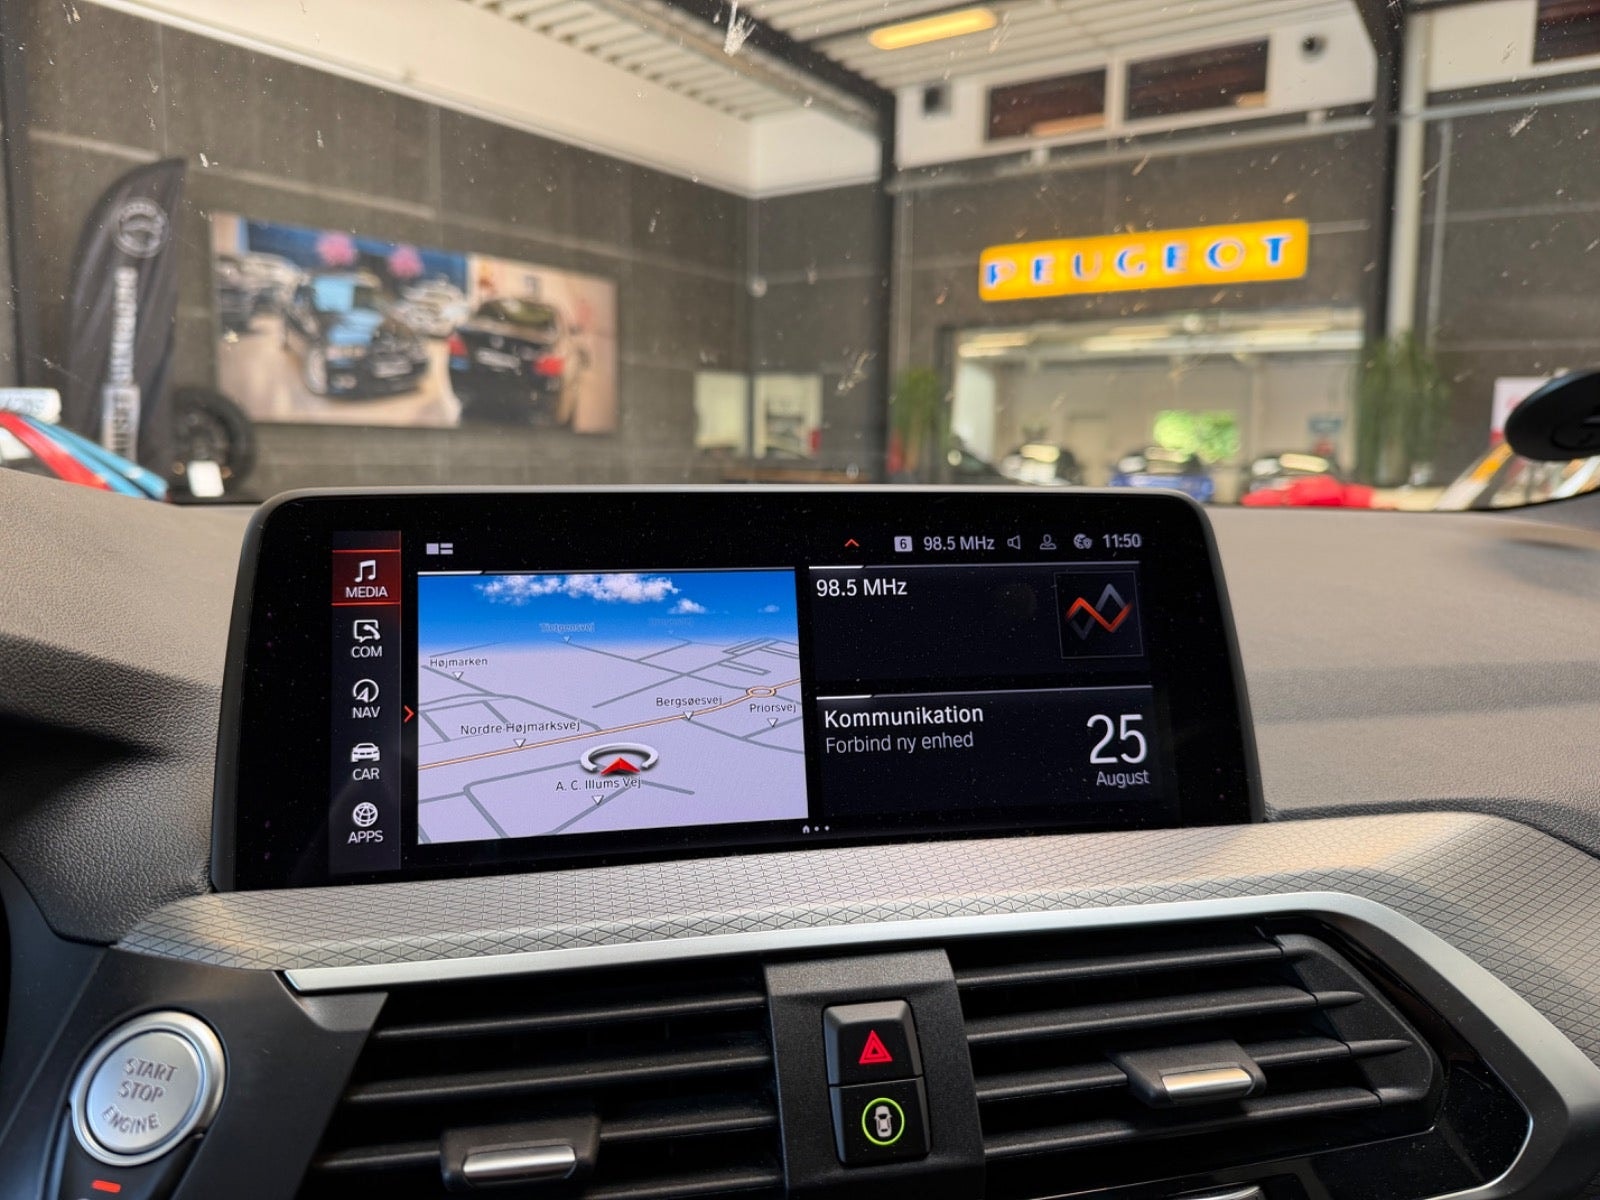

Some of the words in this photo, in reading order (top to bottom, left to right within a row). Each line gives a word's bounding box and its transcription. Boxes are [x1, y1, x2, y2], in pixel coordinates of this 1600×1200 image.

[985, 233, 1292, 288] PEUGEOT
[899, 537, 909, 550] 6
[923, 535, 956, 551] 98.5
[959, 535, 995, 551] MHz
[1102, 533, 1142, 549] 11:50
[345, 585, 389, 599] MEDIA
[816, 578, 858, 597] 98.5
[863, 578, 908, 596] MHz
[350, 644, 383, 659] COM
[429, 656, 489, 670] Højmarken
[655, 697, 723, 709] Bergsøesvej
[749, 703, 797, 713] Priorsvej
[352, 705, 381, 719] NAV
[824, 705, 984, 729] Kommunikation
[460, 723, 503, 736] Nordre
[505, 719, 582, 735] Højmarksvej
[825, 735, 892, 754] Forbind
[896, 738, 917, 756] ny
[921, 731, 974, 750] enhed
[1086, 713, 1147, 765] 25
[352, 766, 380, 781] CAR
[1095, 769, 1151, 789] August
[570, 780, 583, 792] C.
[622, 775, 643, 792] Vej
[347, 829, 384, 844] APPS
[125, 1058, 178, 1081] START
[120, 1080, 164, 1102] STOP
[103, 1104, 159, 1133] ENGINE
